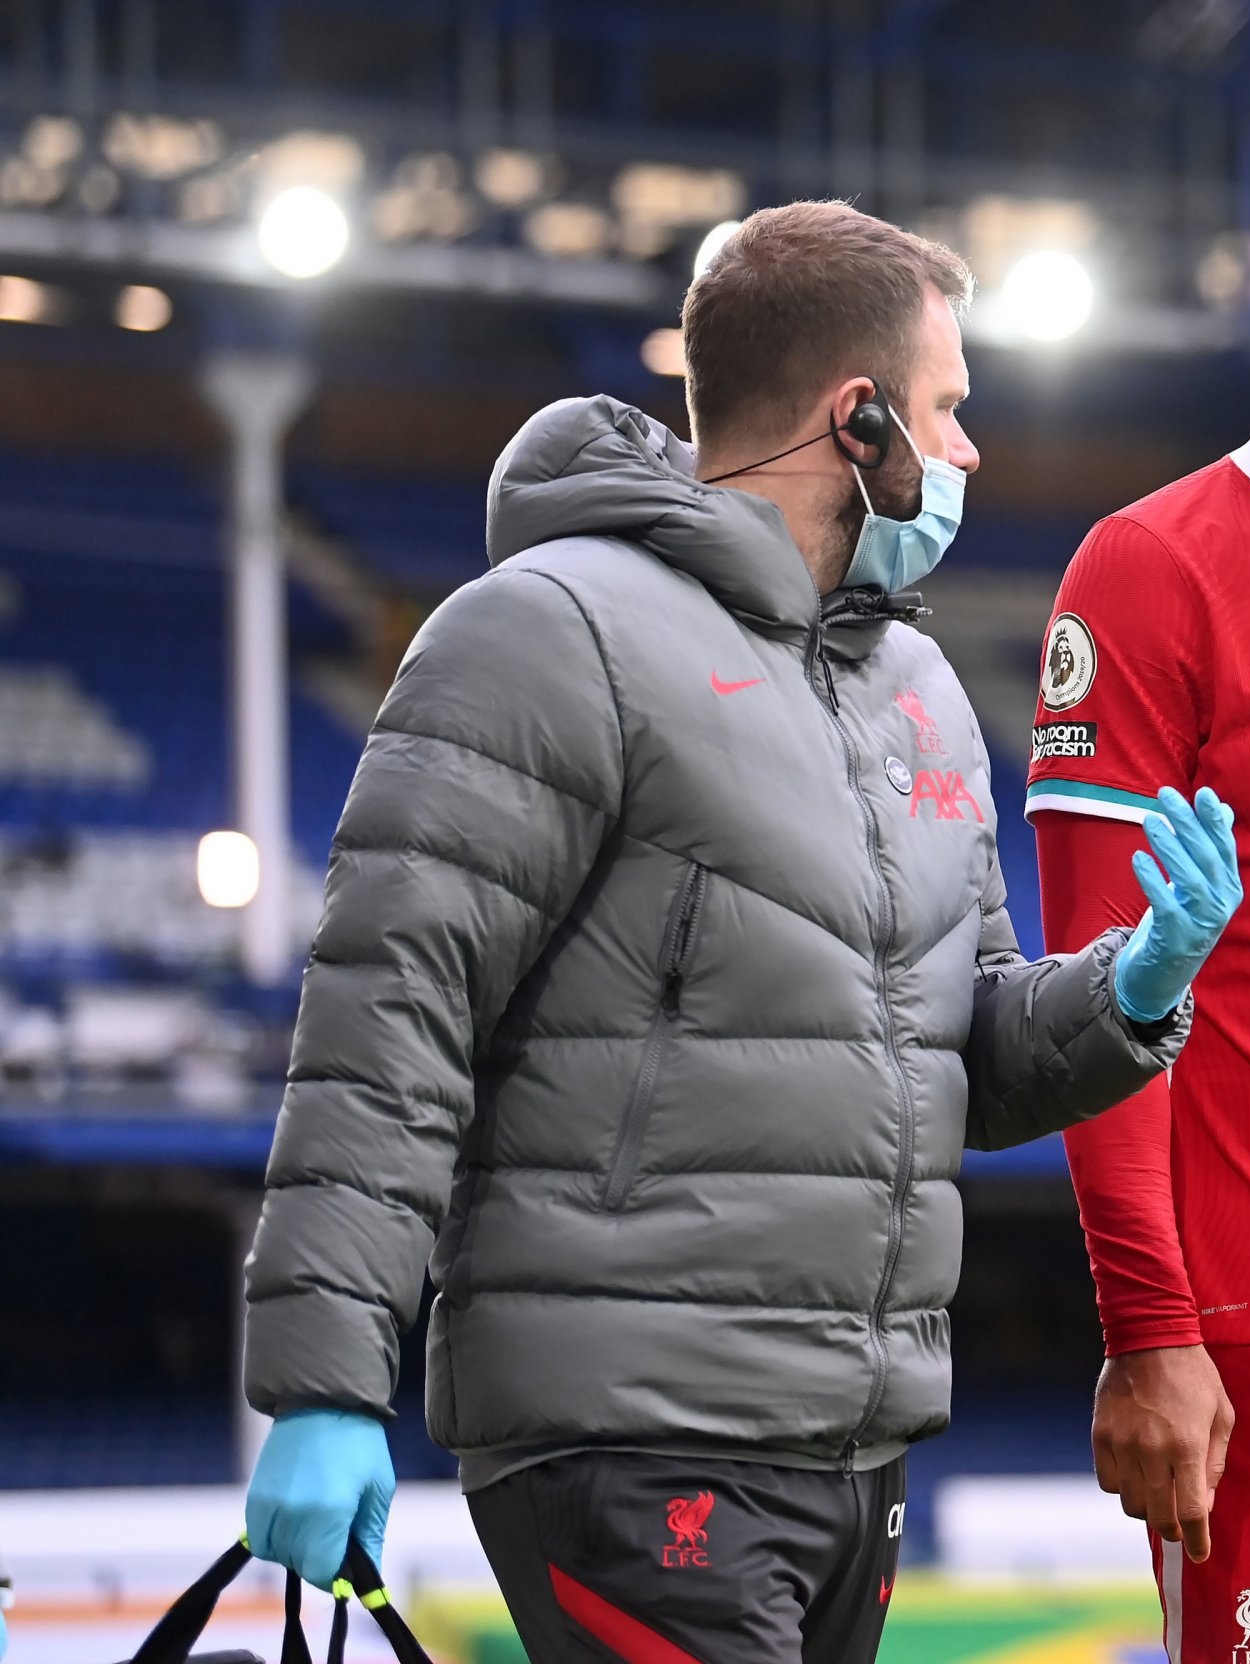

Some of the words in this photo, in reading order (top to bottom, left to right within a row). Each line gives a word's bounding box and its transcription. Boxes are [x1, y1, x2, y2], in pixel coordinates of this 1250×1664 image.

[1032, 726, 1046, 744] No
[1046, 725, 1087, 742] room
[1041, 742, 1095, 758] racism
[909, 769, 985, 824] AXA
